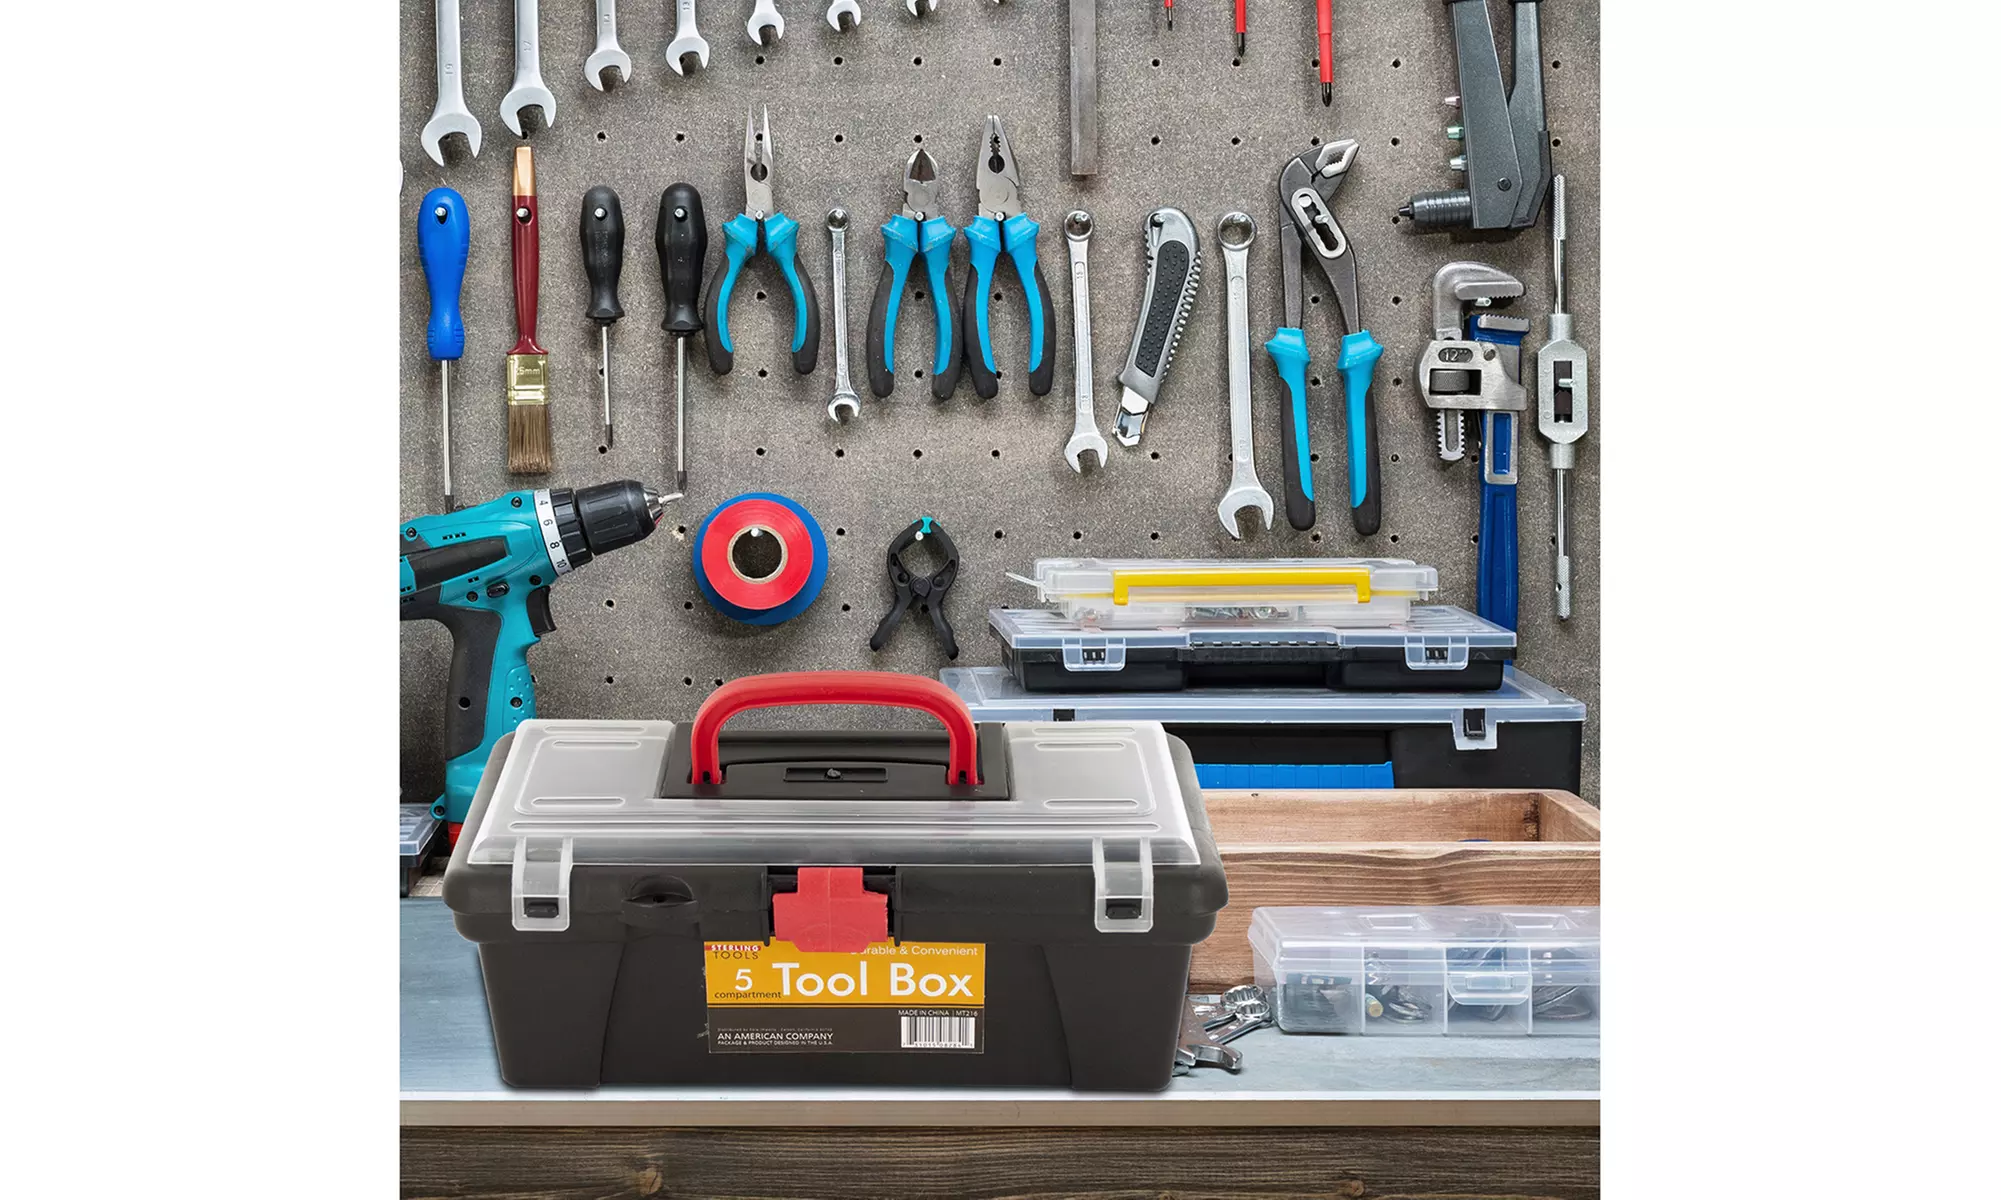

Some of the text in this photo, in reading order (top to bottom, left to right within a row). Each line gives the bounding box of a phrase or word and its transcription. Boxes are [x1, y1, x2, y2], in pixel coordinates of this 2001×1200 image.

[543, 518, 554, 527] 6
[549, 541, 560, 550] 8
[556, 559, 567, 569] 10
[711, 944, 760, 952] STERLING
[899, 945, 909, 955] &
[911, 945, 979, 956] Convenient
[713, 951, 759, 960] TOOLS
[735, 968, 753, 991] 5
[771, 960, 974, 997] Tool Box
[714, 991, 782, 1000] compartment
[717, 1032, 834, 1040] AN AMERICAN COMPANY
